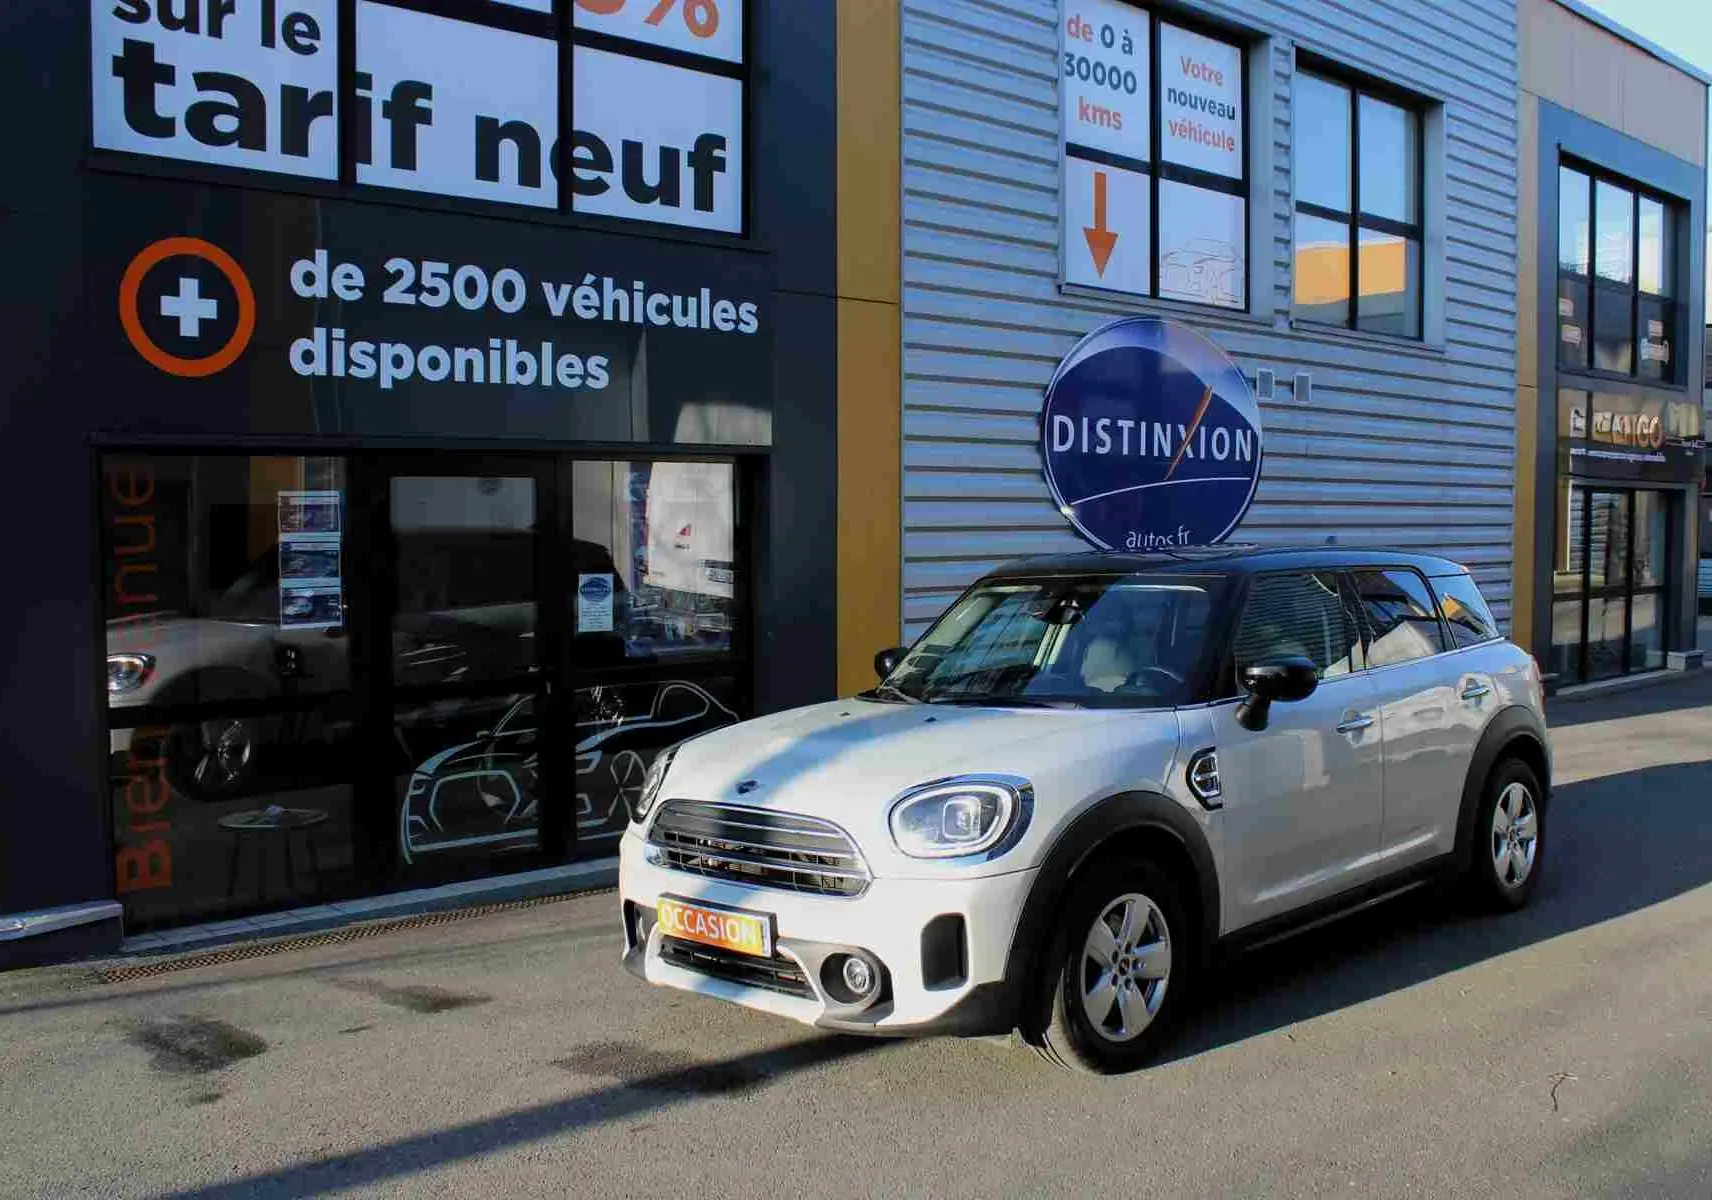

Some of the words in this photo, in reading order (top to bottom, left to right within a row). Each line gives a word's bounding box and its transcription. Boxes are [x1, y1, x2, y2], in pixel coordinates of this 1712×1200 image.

[112, 0, 236, 39] sur
[261, 0, 321, 56] le
[1066, 14, 1094, 44] de
[1122, 30, 1134, 56] à
[1064, 53, 1138, 95] 30000
[1180, 55, 1224, 87] Votre
[1078, 97, 1123, 131] kms
[1167, 86, 1236, 121] nouveau
[112, 38, 433, 171] tarif
[475, 114, 727, 213] neuf
[1168, 118, 1236, 152] véhicule
[290, 250, 365, 300] de
[383, 257, 527, 315] 2500
[542, 273, 759, 334] véhicules
[289, 328, 610, 389] disponibles
[1052, 415, 1252, 462] DISTINXION
[1126, 525, 1190, 549] autosfr
[659, 905, 759, 947] OCCASION
